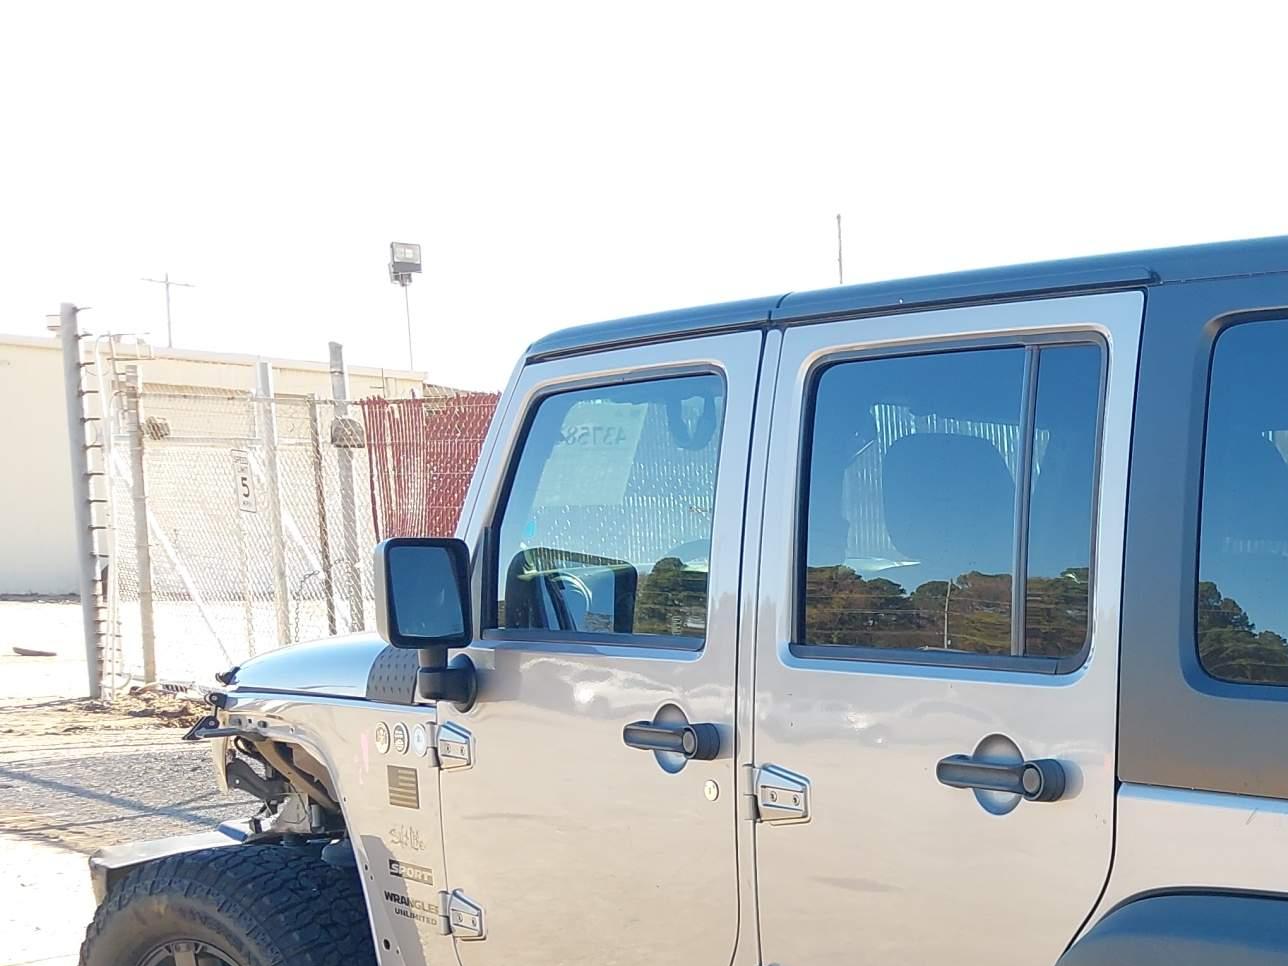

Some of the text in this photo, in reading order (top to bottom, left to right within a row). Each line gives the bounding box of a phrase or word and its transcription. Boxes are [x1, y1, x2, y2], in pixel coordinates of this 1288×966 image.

[240, 476, 250, 498] 5
[389, 863, 433, 881] SPORT
[394, 906, 438, 926] UNLIMITED
